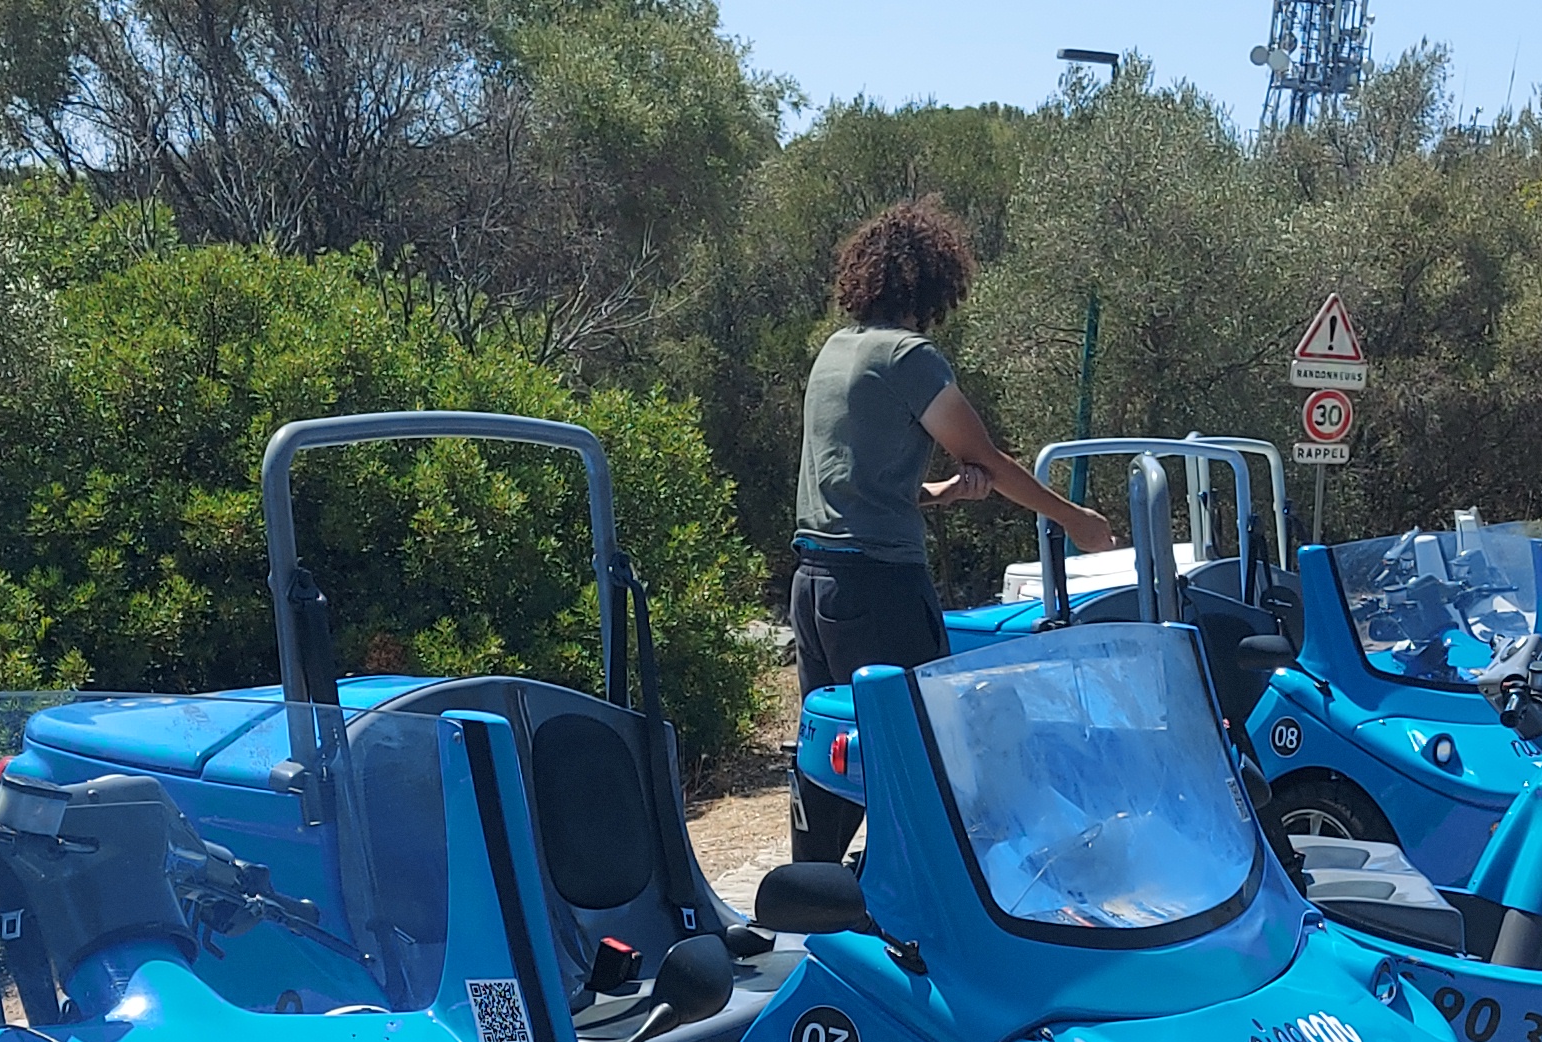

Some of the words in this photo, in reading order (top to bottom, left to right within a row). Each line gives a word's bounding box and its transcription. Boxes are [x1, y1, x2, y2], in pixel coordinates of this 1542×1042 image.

[1314, 404, 1343, 427] 30
[1297, 447, 1346, 459] RAPPEL
[1274, 725, 1298, 749] 08
